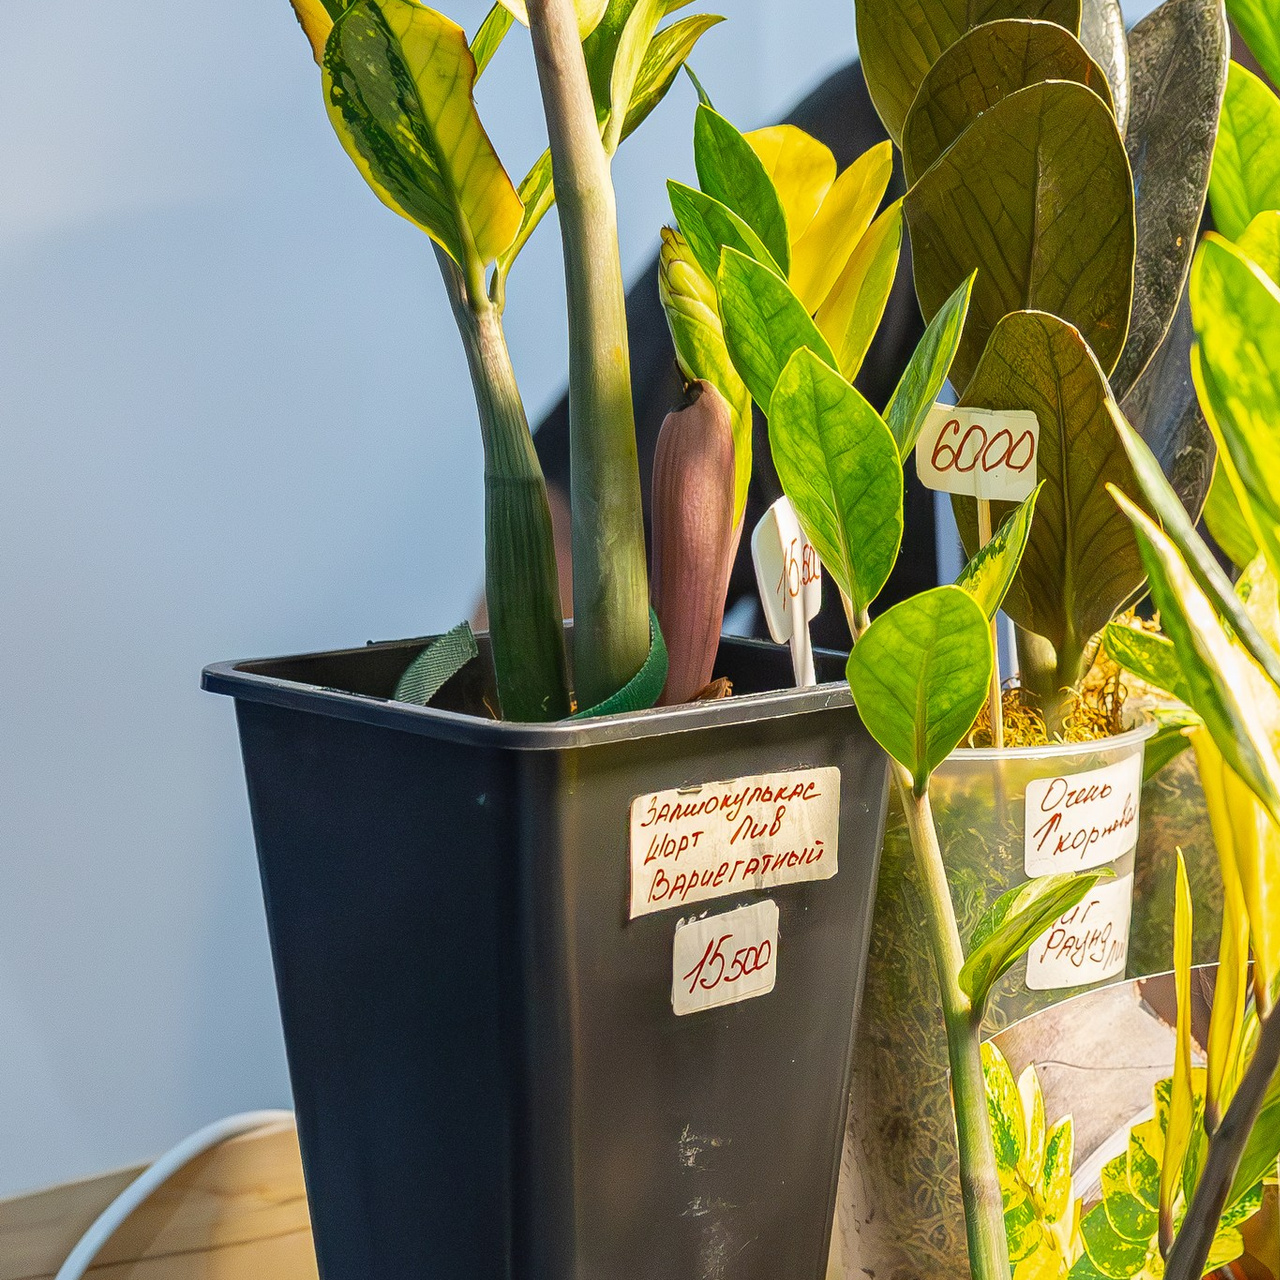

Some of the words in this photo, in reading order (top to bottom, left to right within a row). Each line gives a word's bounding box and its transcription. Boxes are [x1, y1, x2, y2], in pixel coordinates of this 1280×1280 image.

[931, 419, 1035, 474] 6000
[1041, 777, 1112, 812] Очень
[644, 831, 704, 866] Шорт
[683, 934, 772, 994] 15500
